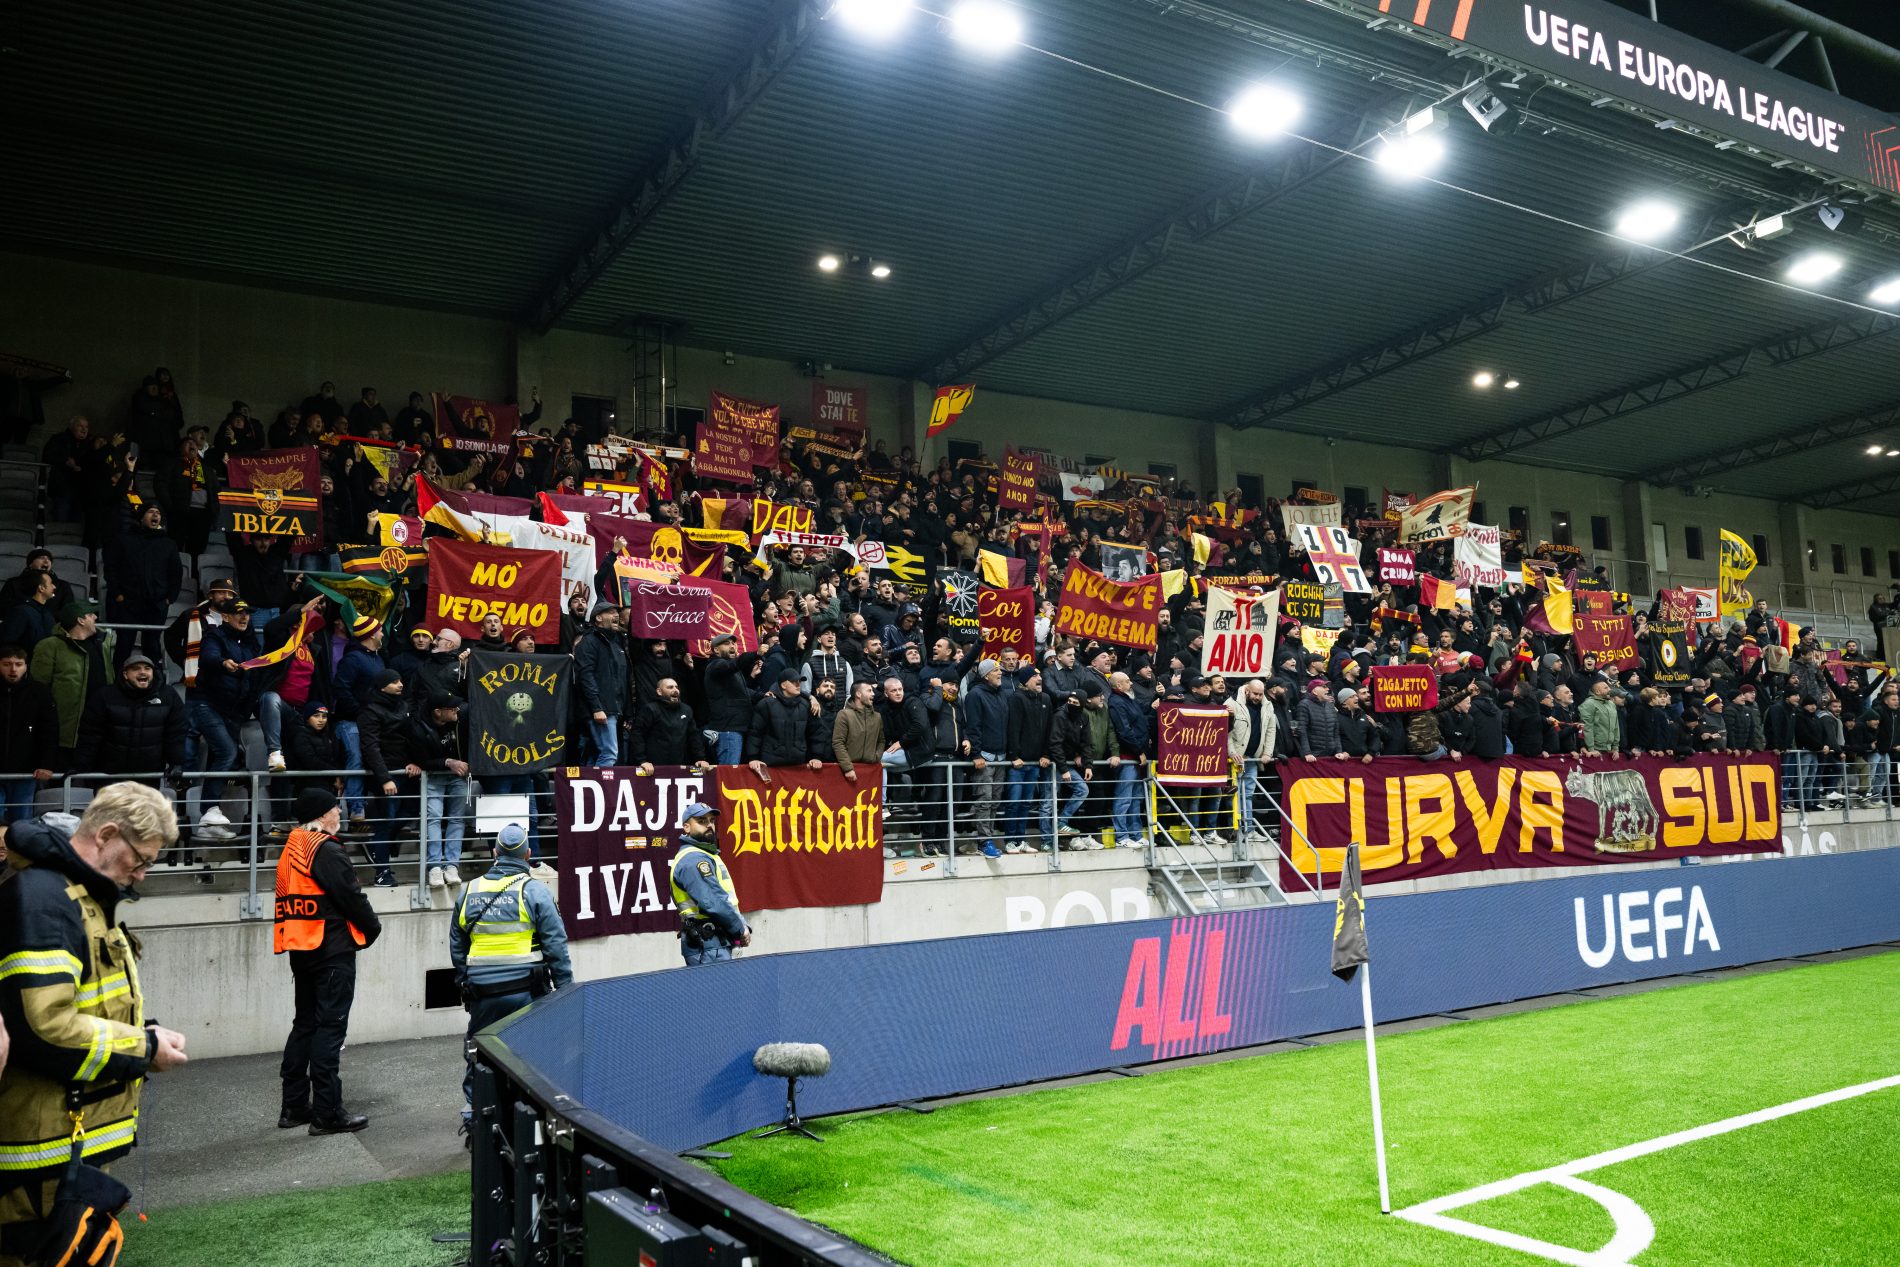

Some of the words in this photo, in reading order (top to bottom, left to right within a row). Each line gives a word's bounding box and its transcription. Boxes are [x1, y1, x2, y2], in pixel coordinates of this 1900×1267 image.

[1524, 5, 1612, 72] UEFA
[1618, 39, 1735, 116] EUROPA
[826, 390, 853, 406] DOVE
[740, 416, 758, 429] CHE
[820, 405, 842, 421] STAI
[847, 408, 858, 422] TE
[464, 439, 486, 452] SONO
[486, 442, 496, 453] LA
[706, 430, 714, 438] LA
[716, 432, 743, 444] NOSTRA
[716, 443, 734, 454] FEDE
[241, 458, 258, 466] DA
[262, 454, 307, 465] SEMPRE
[714, 454, 728, 464] MAI
[729, 458, 736, 466] TI
[1006, 489, 1027, 504] AMOR
[232, 512, 306, 536] IBIZA
[773, 531, 792, 543] TI
[799, 532, 844, 548] AMO
[1304, 526, 1320, 551] 1
[1332, 529, 1348, 553] 9
[1383, 550, 1412, 564] ROMA
[1214, 576, 1240, 585] FORZA
[1247, 576, 1270, 584] ROMA
[1346, 568, 1364, 590] 7
[1381, 567, 1414, 580] CRUDA
[1066, 568, 1122, 604] NUN
[438, 594, 548, 628] VEDEMO
[979, 591, 1022, 618] Cor
[1233, 598, 1256, 630] TI
[1302, 602, 1321, 618] STA
[646, 604, 705, 628] Facce
[1057, 605, 1157, 646] PROBLEMA
[1575, 618, 1584, 630] O
[1592, 618, 1624, 631] TUTTI
[985, 626, 1022, 644] ore
[1316, 630, 1339, 639] DAJE
[1603, 635, 1610, 646] O
[1207, 634, 1263, 673] AMO
[478, 662, 558, 696] ROMA
[1378, 678, 1428, 692] ZAGAJETTO
[1386, 694, 1403, 708] CON
[1406, 694, 1422, 708] NOI
[1161, 707, 1224, 745] Emilio
[480, 729, 566, 766] HOOLS
[1164, 752, 1189, 773] con
[1196, 746, 1223, 773] noi
[570, 778, 704, 832] DAJE
[721, 782, 878, 856] Diffidati
[1288, 767, 1565, 874] CURVA
[1659, 764, 1778, 847] SUD
[1574, 885, 1721, 969] UEFA
[1110, 916, 1231, 1060] ALL
